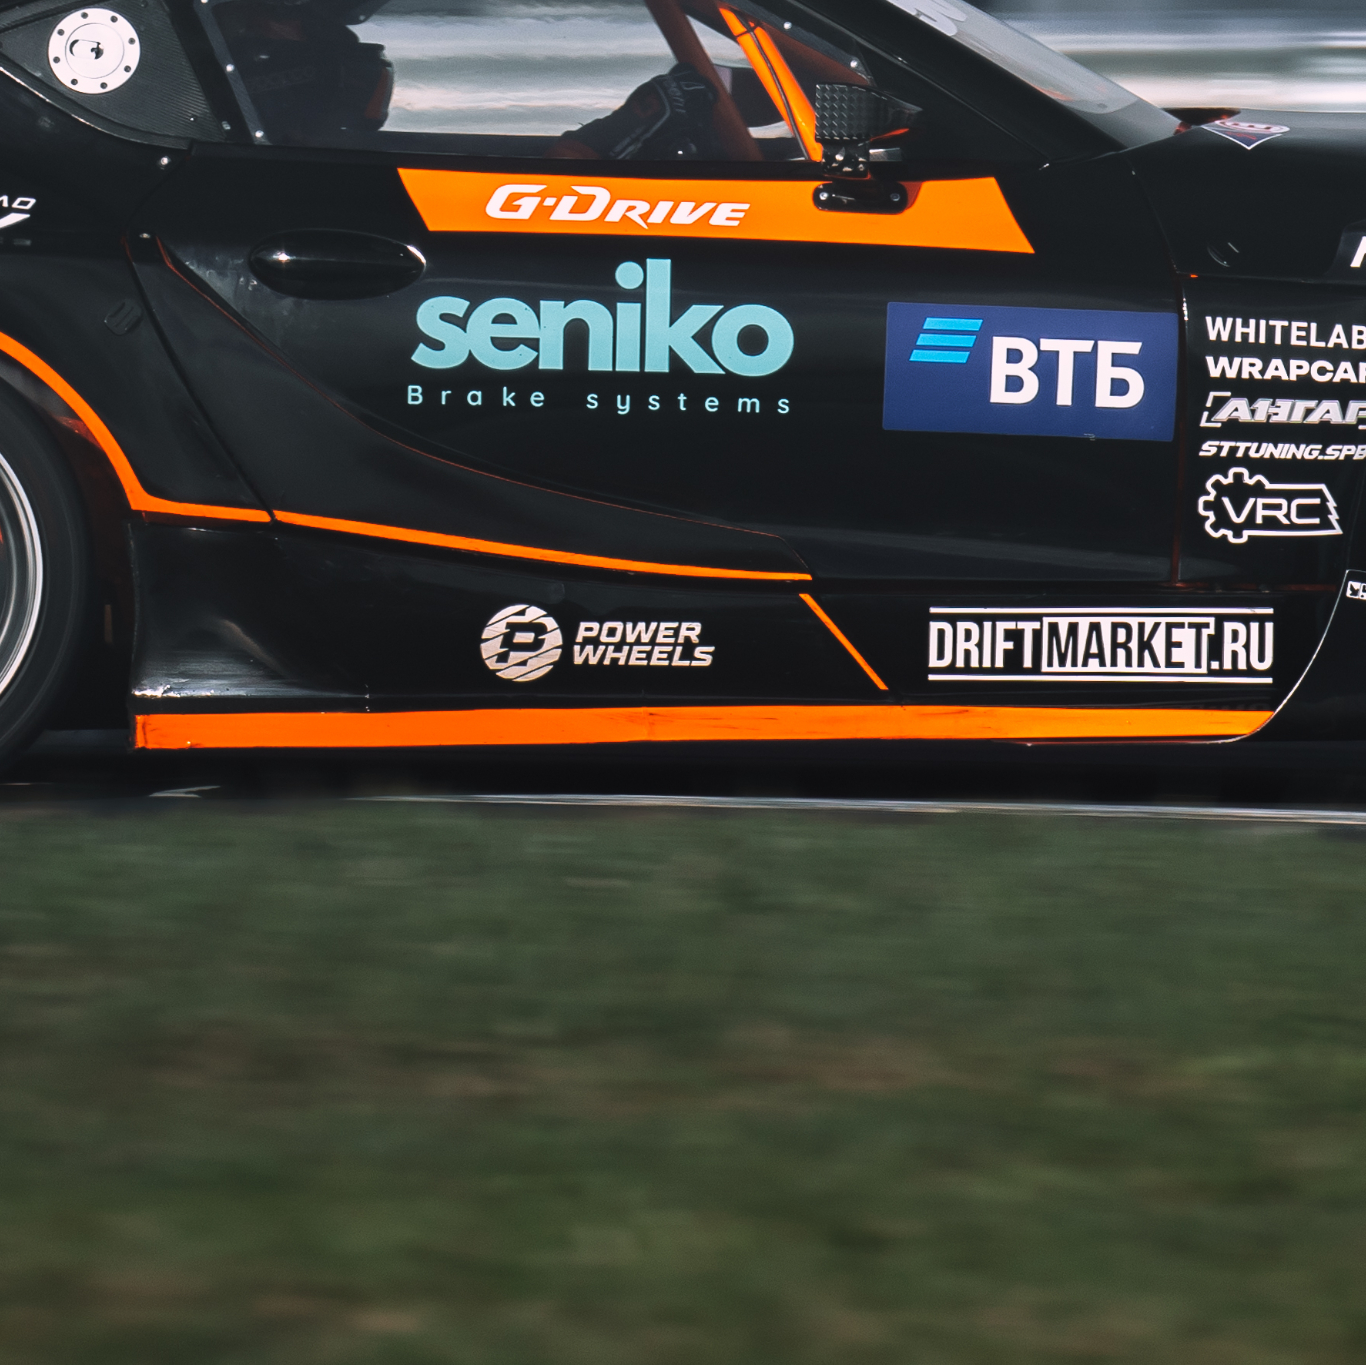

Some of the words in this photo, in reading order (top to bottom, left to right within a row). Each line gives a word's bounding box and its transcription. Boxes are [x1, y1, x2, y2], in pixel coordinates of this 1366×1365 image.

[410, 257, 795, 377] seniko
[989, 336, 1145, 408] ВТБ
[407, 385, 545, 408] Brake
[586, 392, 790, 416] systems
[1221, 496, 1321, 525] VRC
[575, 621, 702, 643] POWER
[928, 617, 1274, 673] DRIFTMARKET.RU
[573, 644, 716, 667] WHEELS
